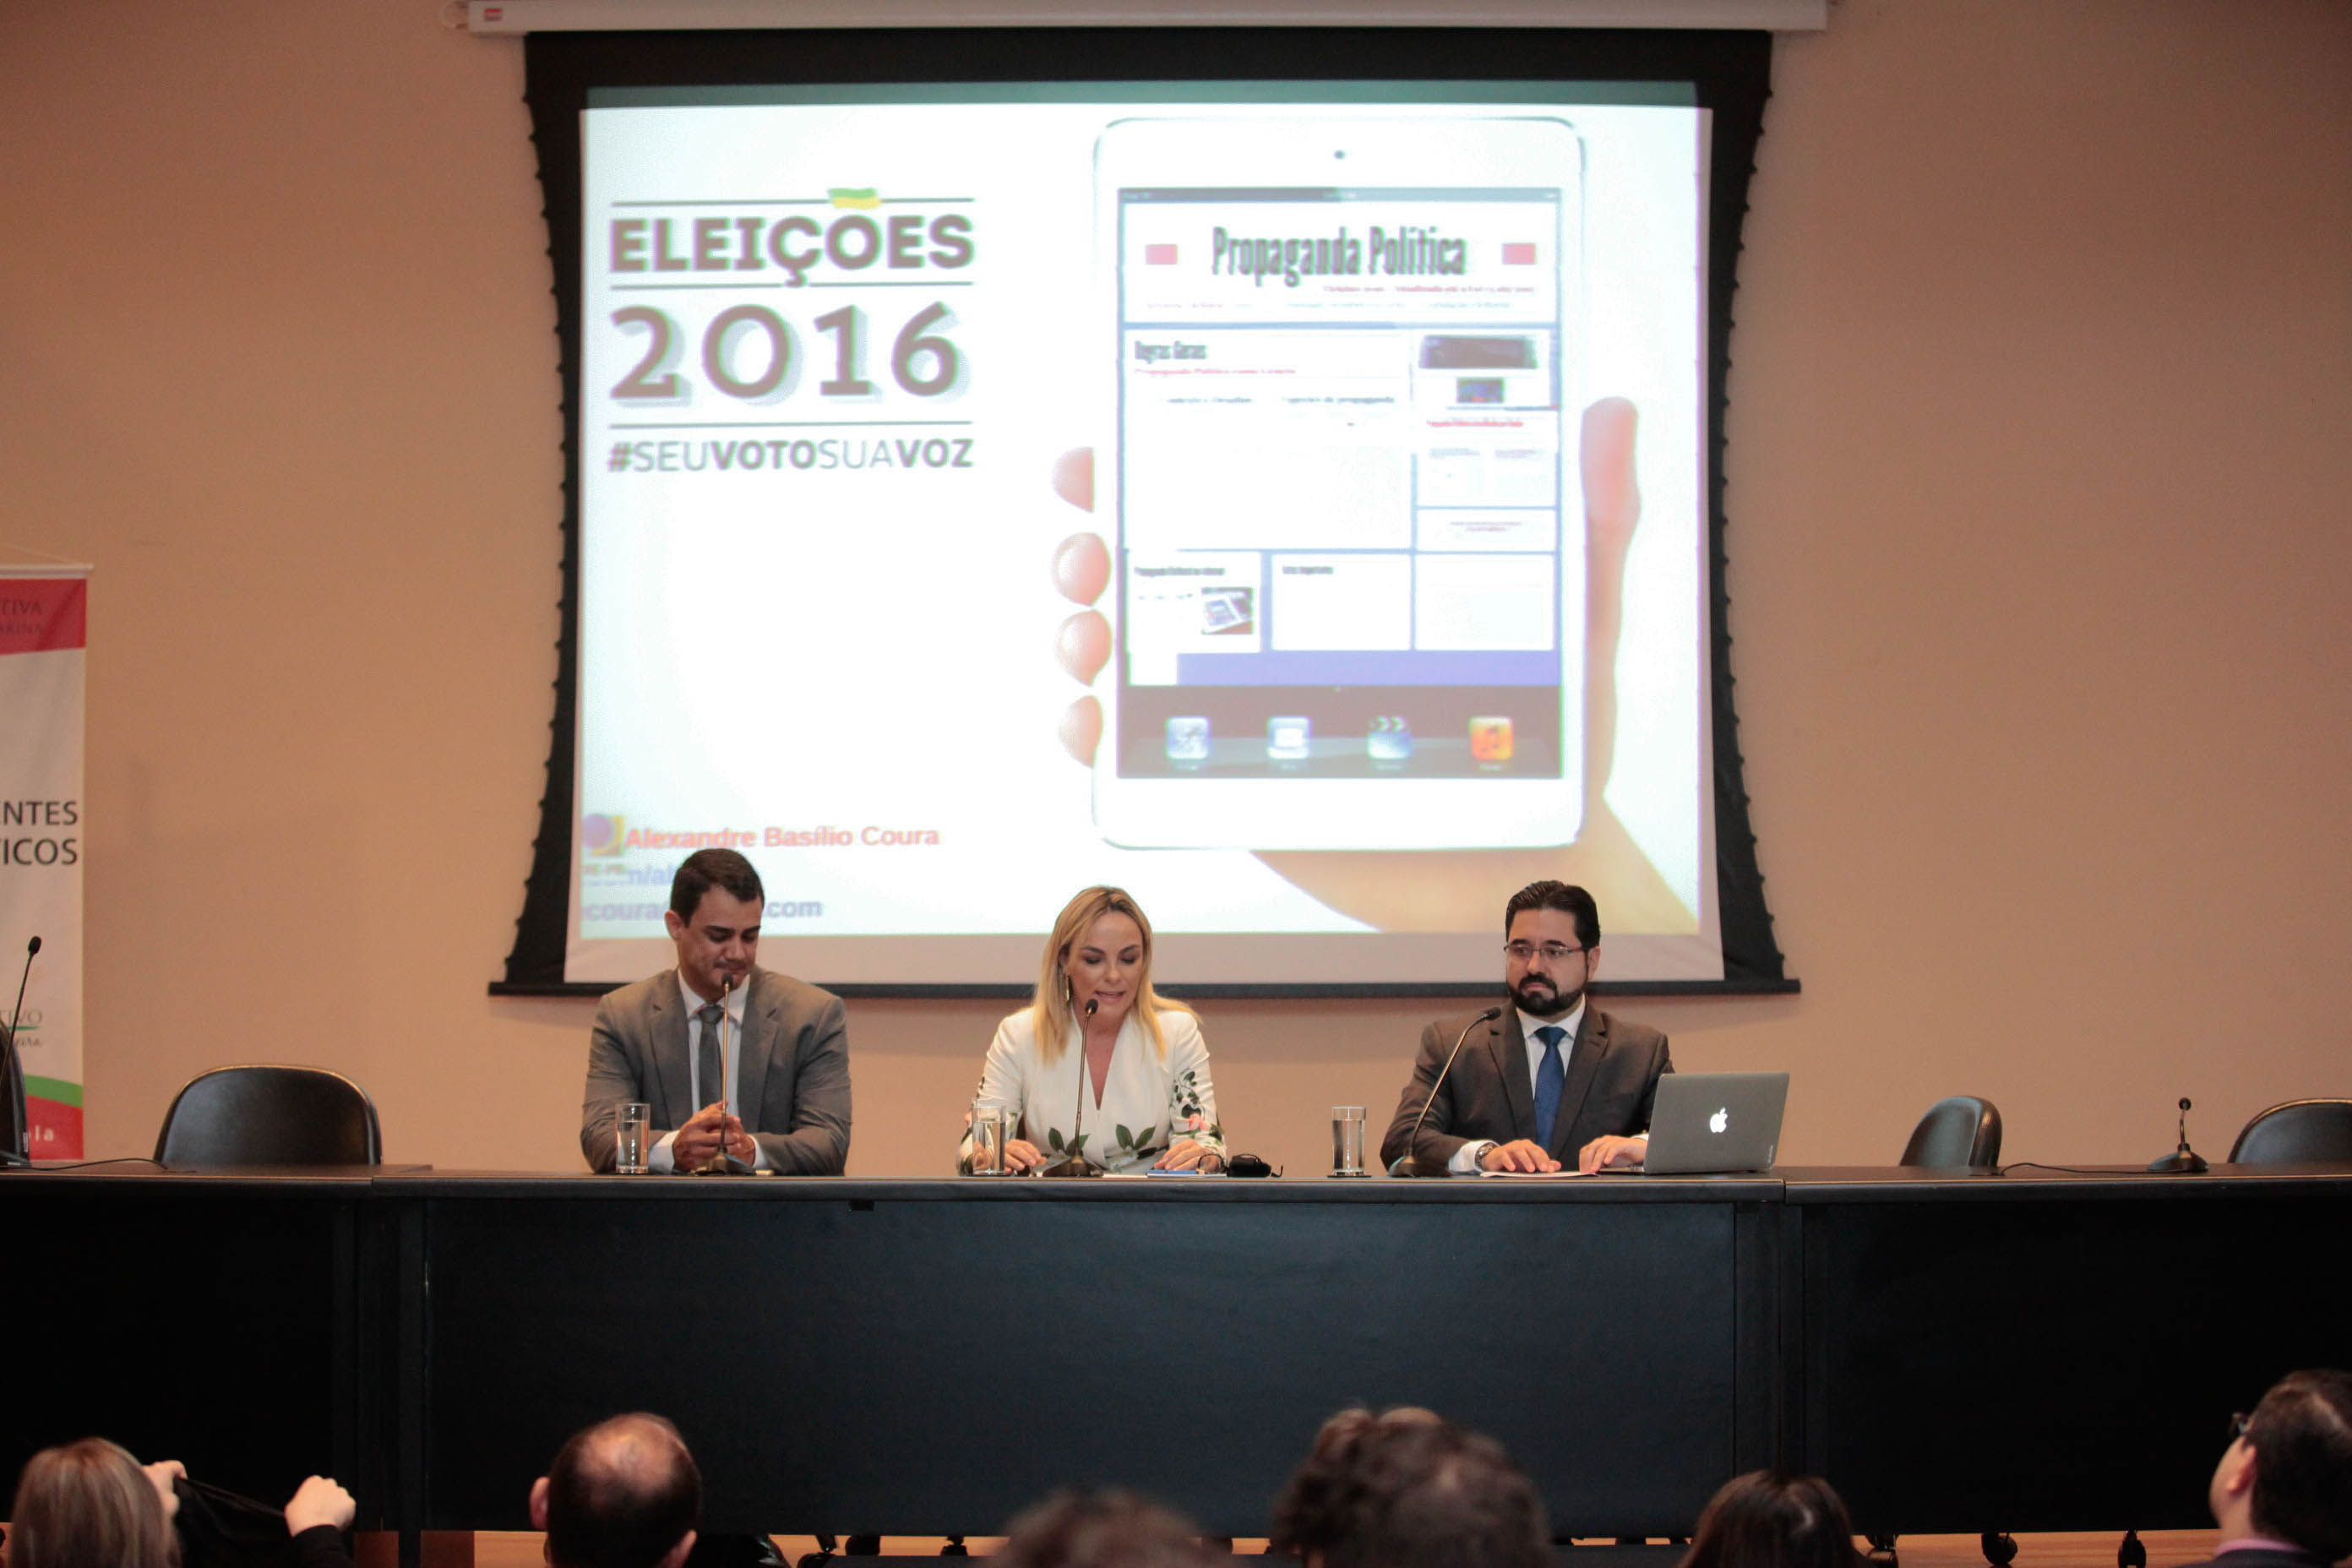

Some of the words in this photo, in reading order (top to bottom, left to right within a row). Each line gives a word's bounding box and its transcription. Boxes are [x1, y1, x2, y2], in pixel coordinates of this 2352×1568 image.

[1211, 226, 1361, 287] Propaganda
[609, 302, 970, 406] 2016
[607, 438, 974, 472] #SEUVOTOSUAVOZ
[0, 800, 78, 825] NTES
[0, 838, 78, 865] ICOS
[626, 827, 757, 848] Alexandre
[861, 825, 940, 846] Coura
